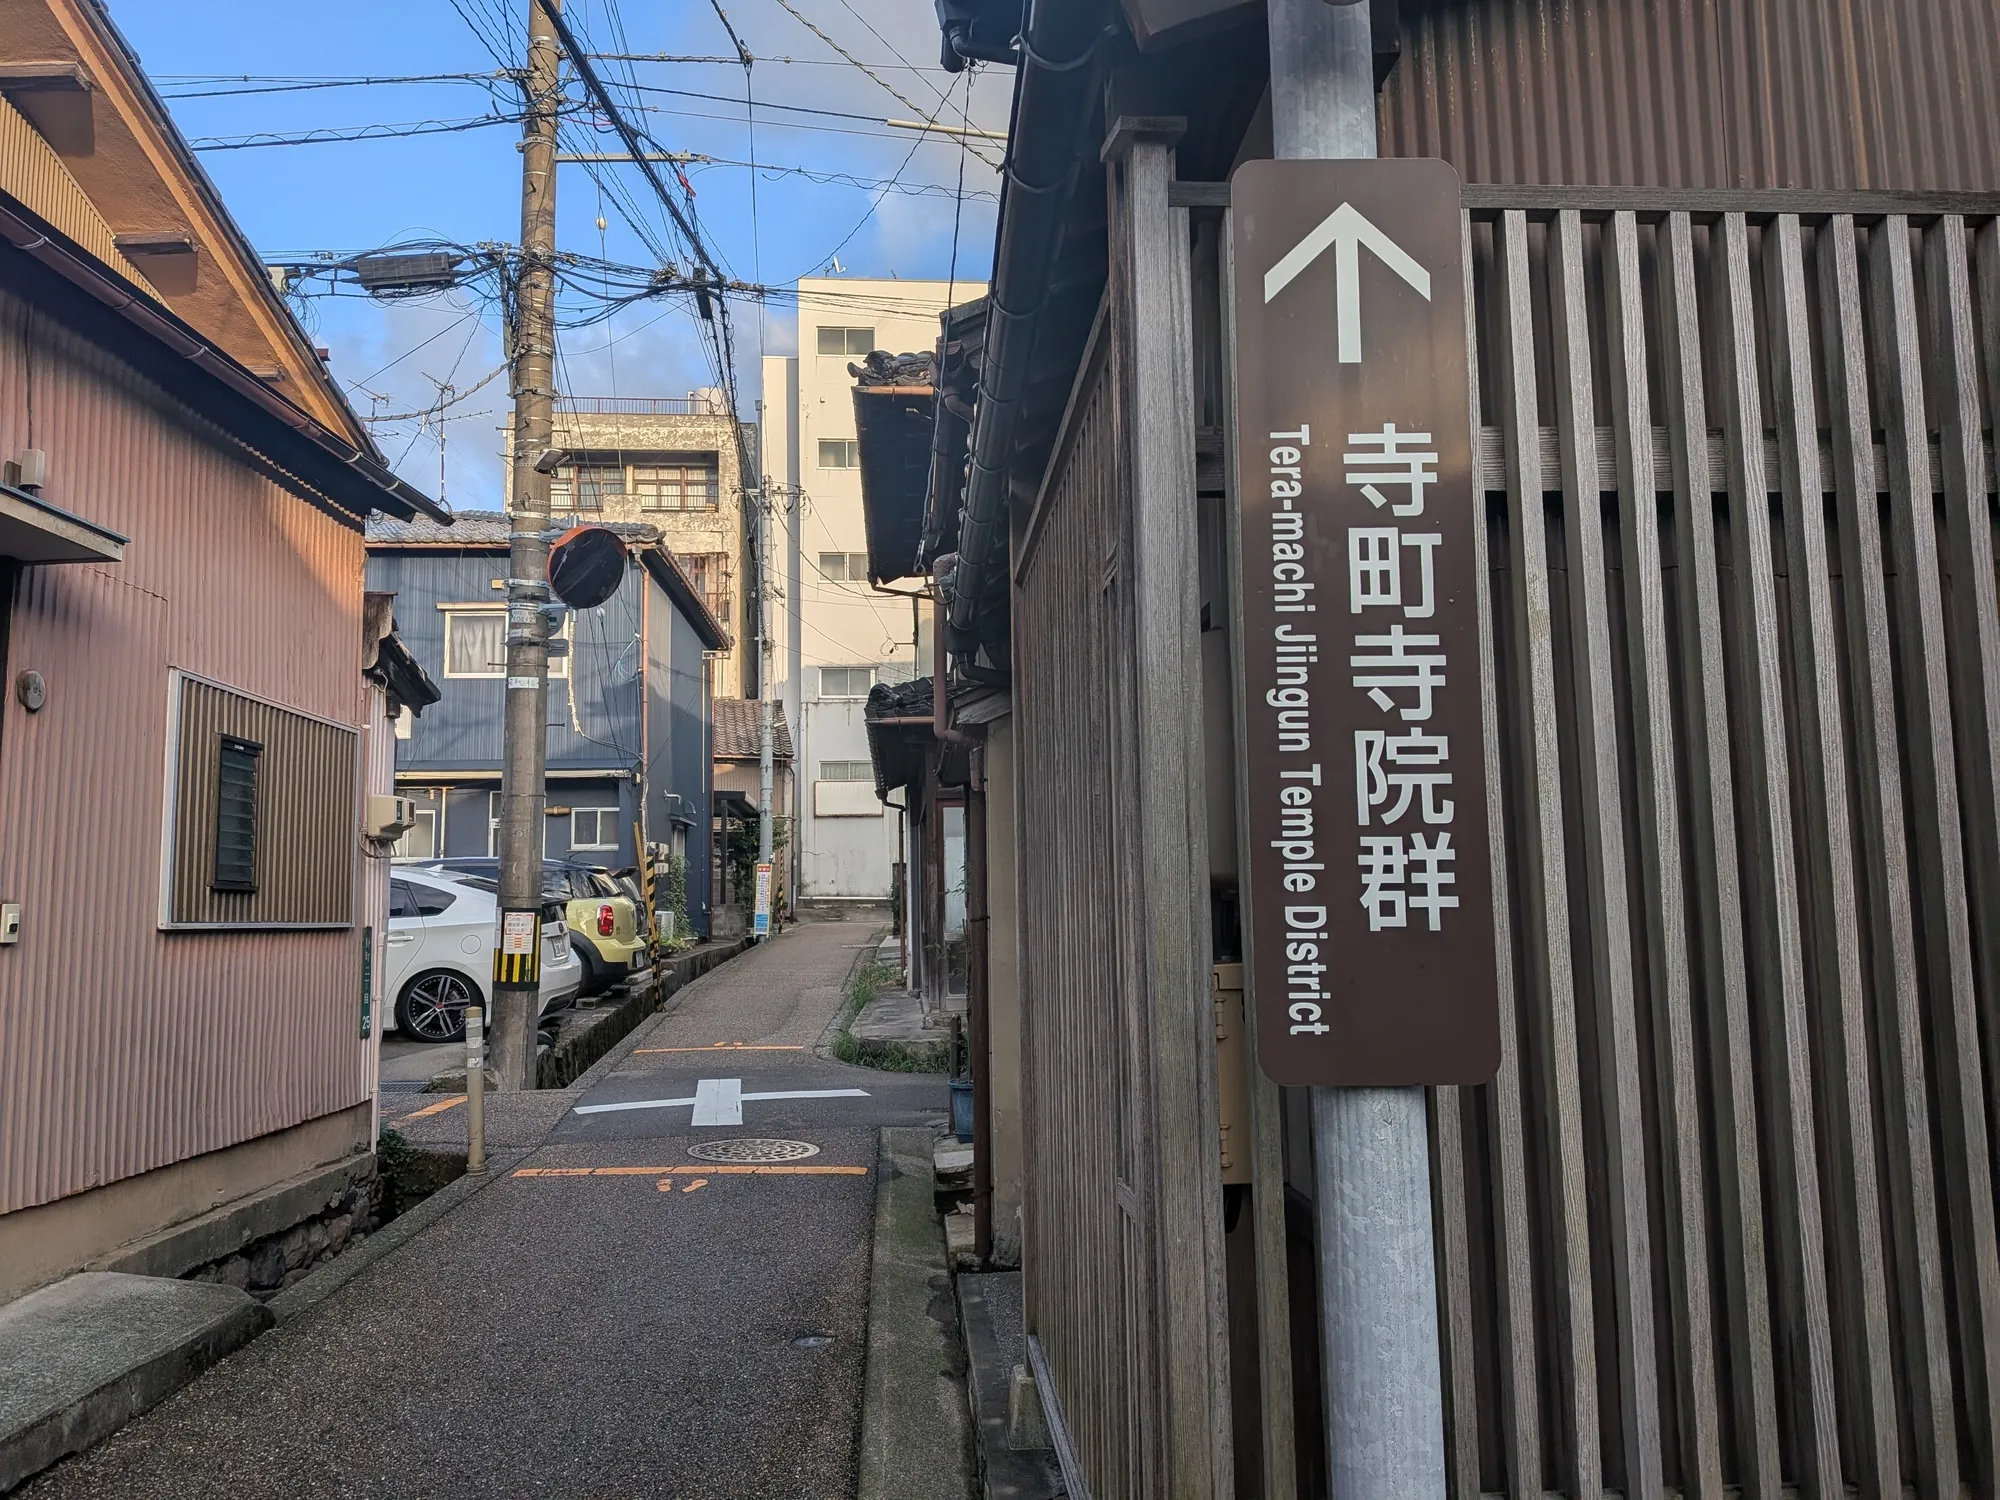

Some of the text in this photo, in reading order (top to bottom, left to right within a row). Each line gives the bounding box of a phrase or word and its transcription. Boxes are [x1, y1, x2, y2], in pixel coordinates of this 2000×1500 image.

[1266, 424, 1332, 1036] Tera-machi Jiingun Temple District
[1343, 422, 1460, 933] 寺町寺院群
[362, 1015, 371, 1030] 25
